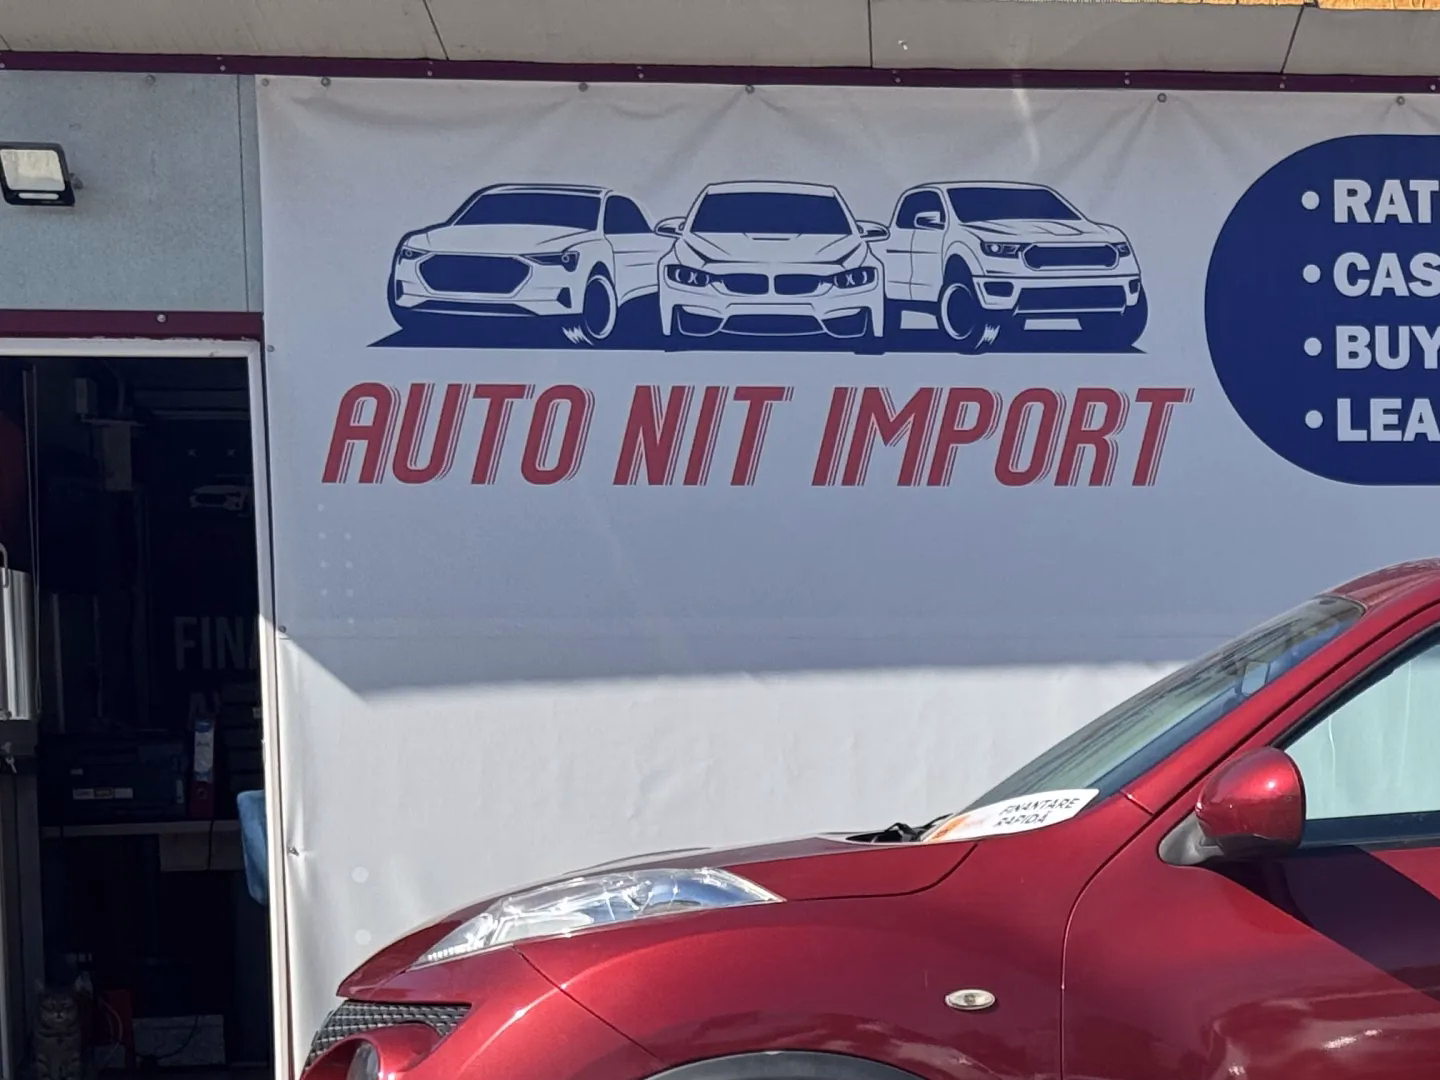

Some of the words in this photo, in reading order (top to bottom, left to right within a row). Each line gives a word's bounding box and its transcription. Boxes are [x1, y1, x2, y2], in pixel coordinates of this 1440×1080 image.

[321, 381, 596, 486] AUTO
[613, 384, 794, 487] NIT
[810, 385, 1195, 488] IMPORT
